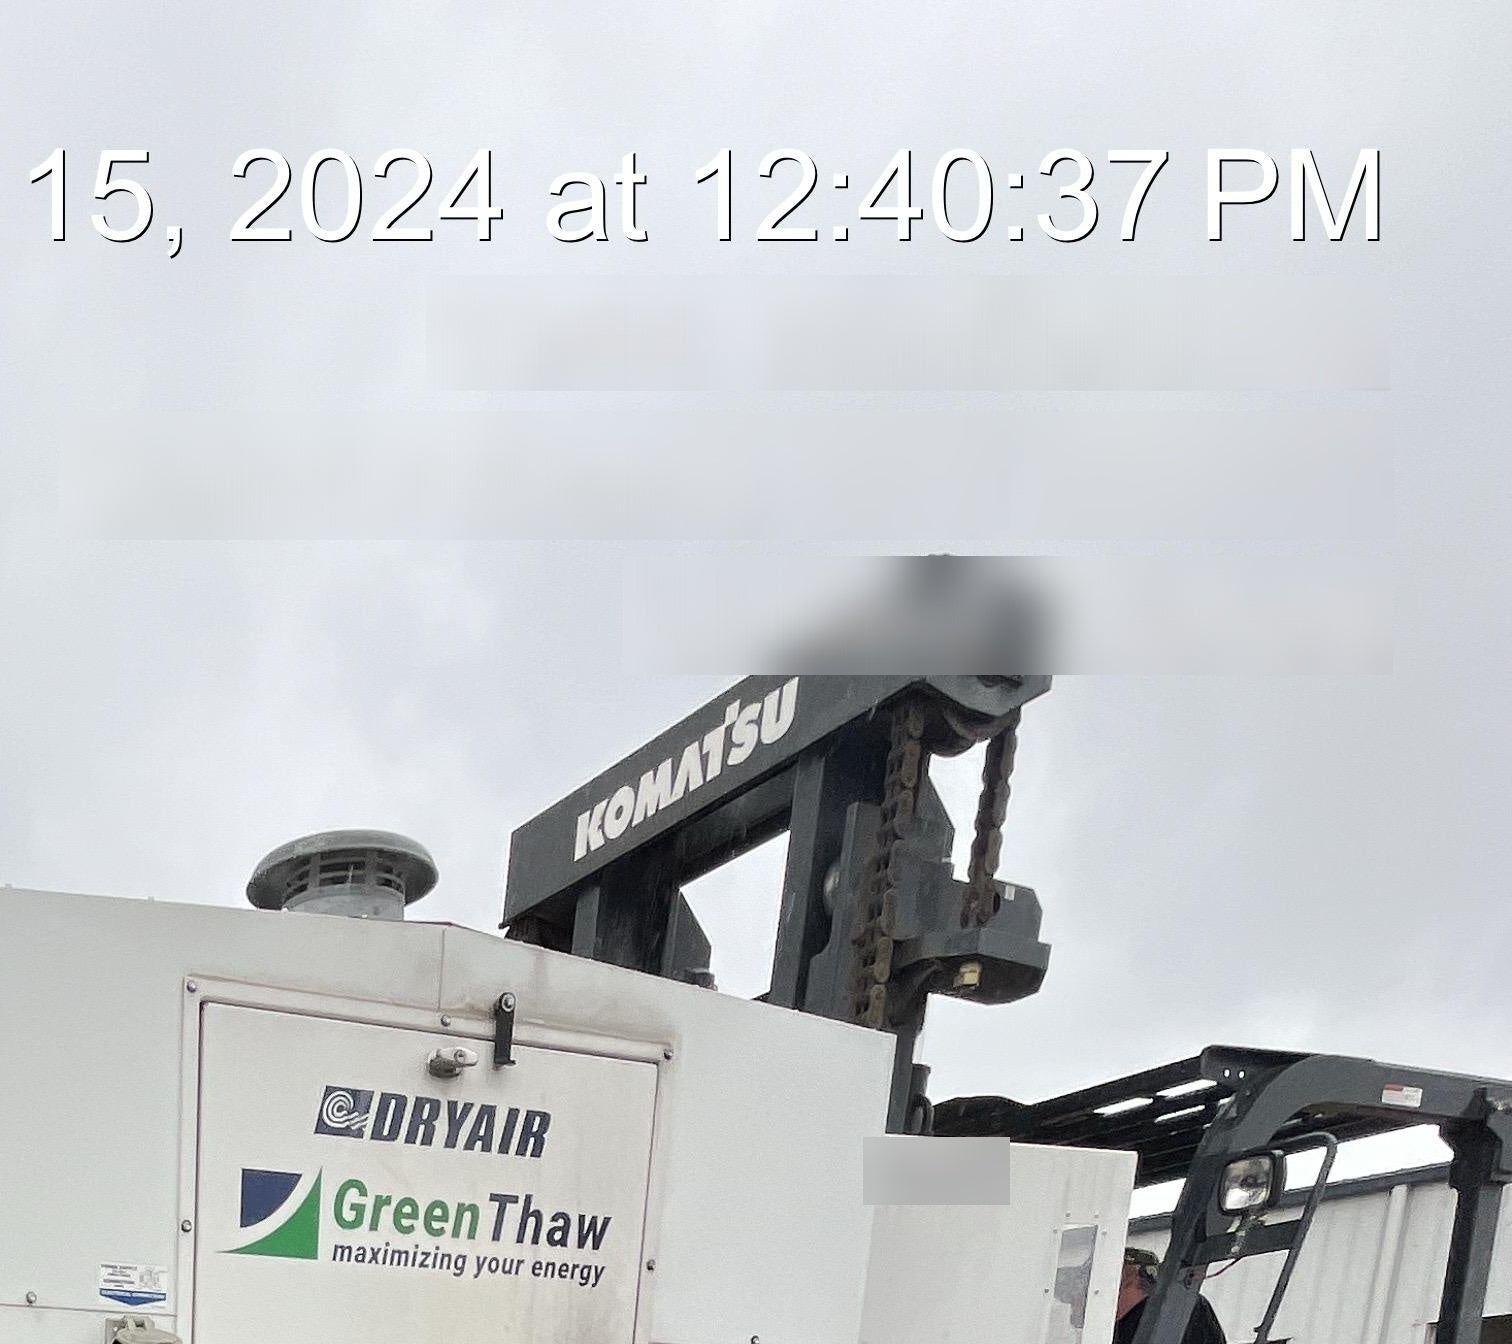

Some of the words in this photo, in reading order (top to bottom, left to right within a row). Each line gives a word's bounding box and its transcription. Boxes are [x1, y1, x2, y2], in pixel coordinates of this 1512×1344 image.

[573, 676, 799, 862] KOMATSU
[370, 1092, 551, 1158] DRYAIR
[332, 1242, 467, 1278] maximizing
[473, 1256, 525, 1279] your
[531, 1260, 606, 1288] energy
